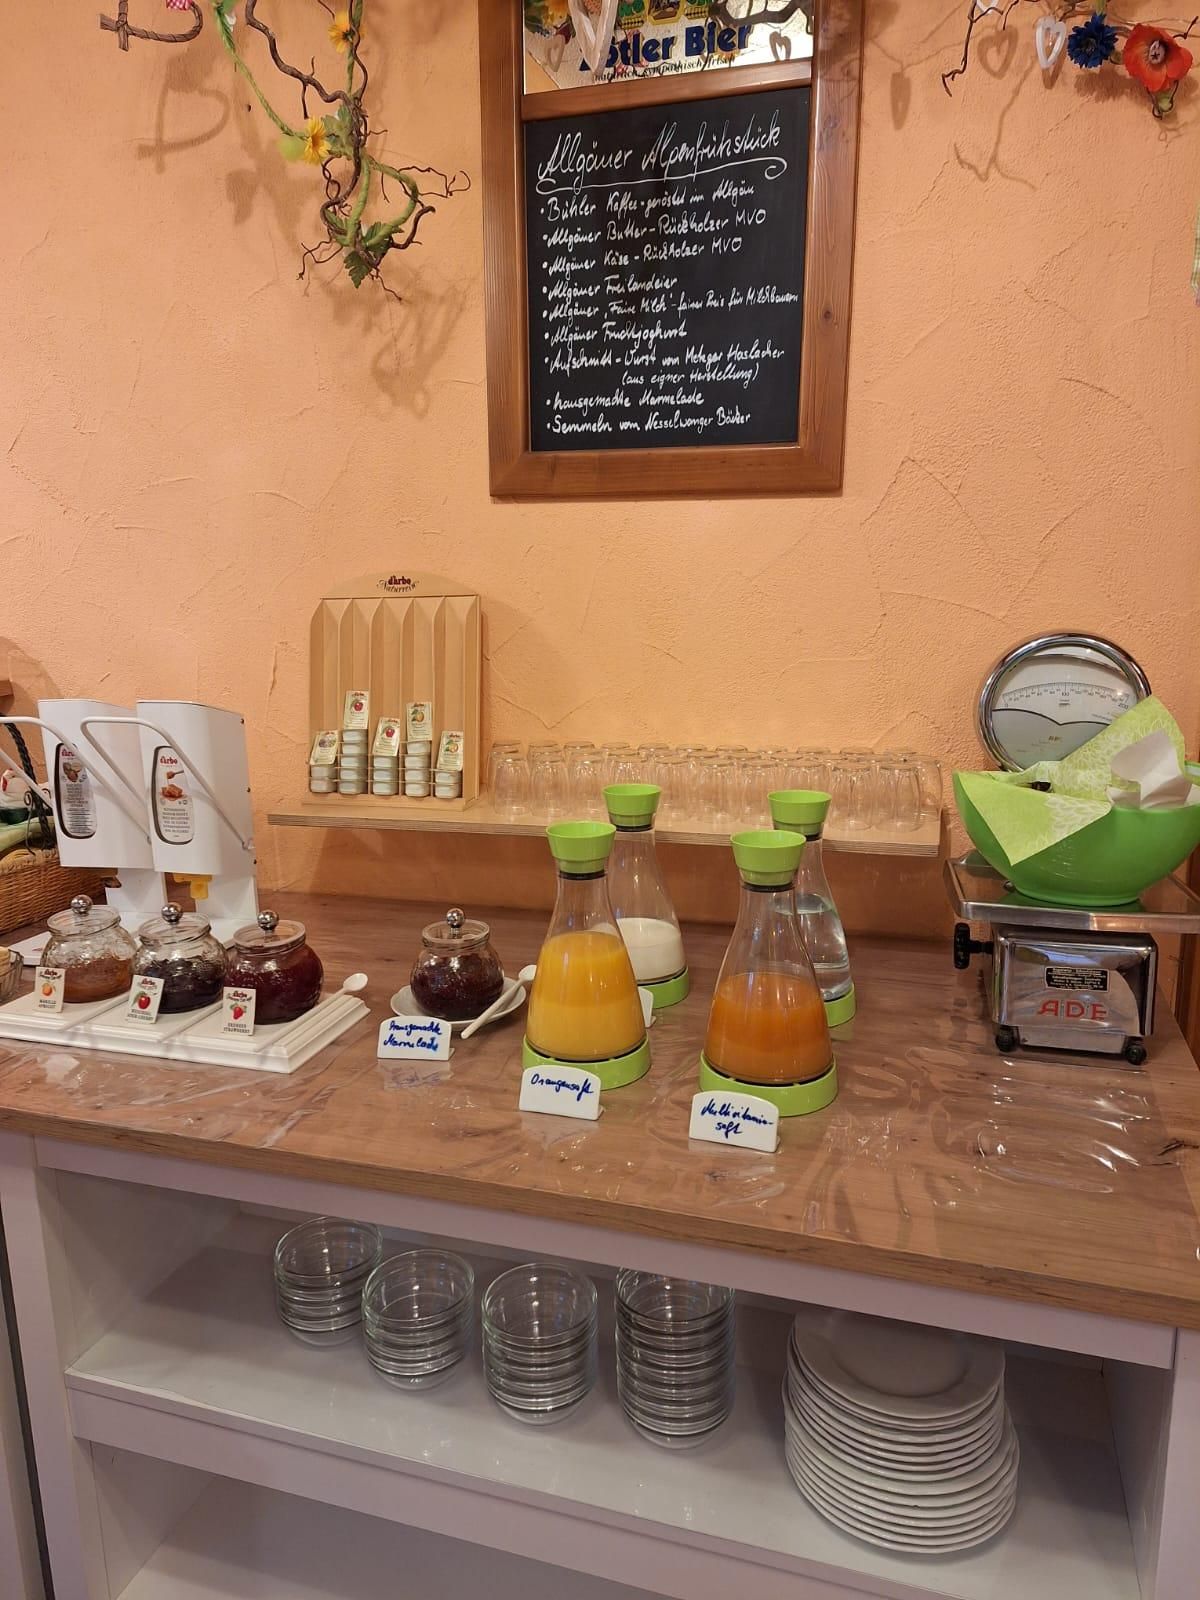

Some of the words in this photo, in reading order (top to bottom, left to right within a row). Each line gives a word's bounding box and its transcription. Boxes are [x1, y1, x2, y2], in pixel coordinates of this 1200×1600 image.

[685, 21, 749, 56] Bier
[537, 132, 633, 194] Allgäuer
[641, 109, 781, 182] Alpenfrühstück
[712, 178, 754, 207] Allgäu
[547, 227, 601, 252] Allgäuer
[735, 209, 766, 227] MVO
[549, 256, 596, 280] Allgäuer
[712, 237, 742, 255] MVO
[548, 280, 600, 305] Allgäuer
[549, 302, 599, 327] Allgäuer
[550, 325, 598, 350] Allgäuer
[621, 370, 644, 386] (aus
[639, 387, 705, 406] Marmelade
[552, 412, 612, 434] Semmeln
[1036, 999, 1108, 1022] ADE
[530, 1073, 594, 1102] Orangensaft
[715, 1121, 743, 1139] saft
